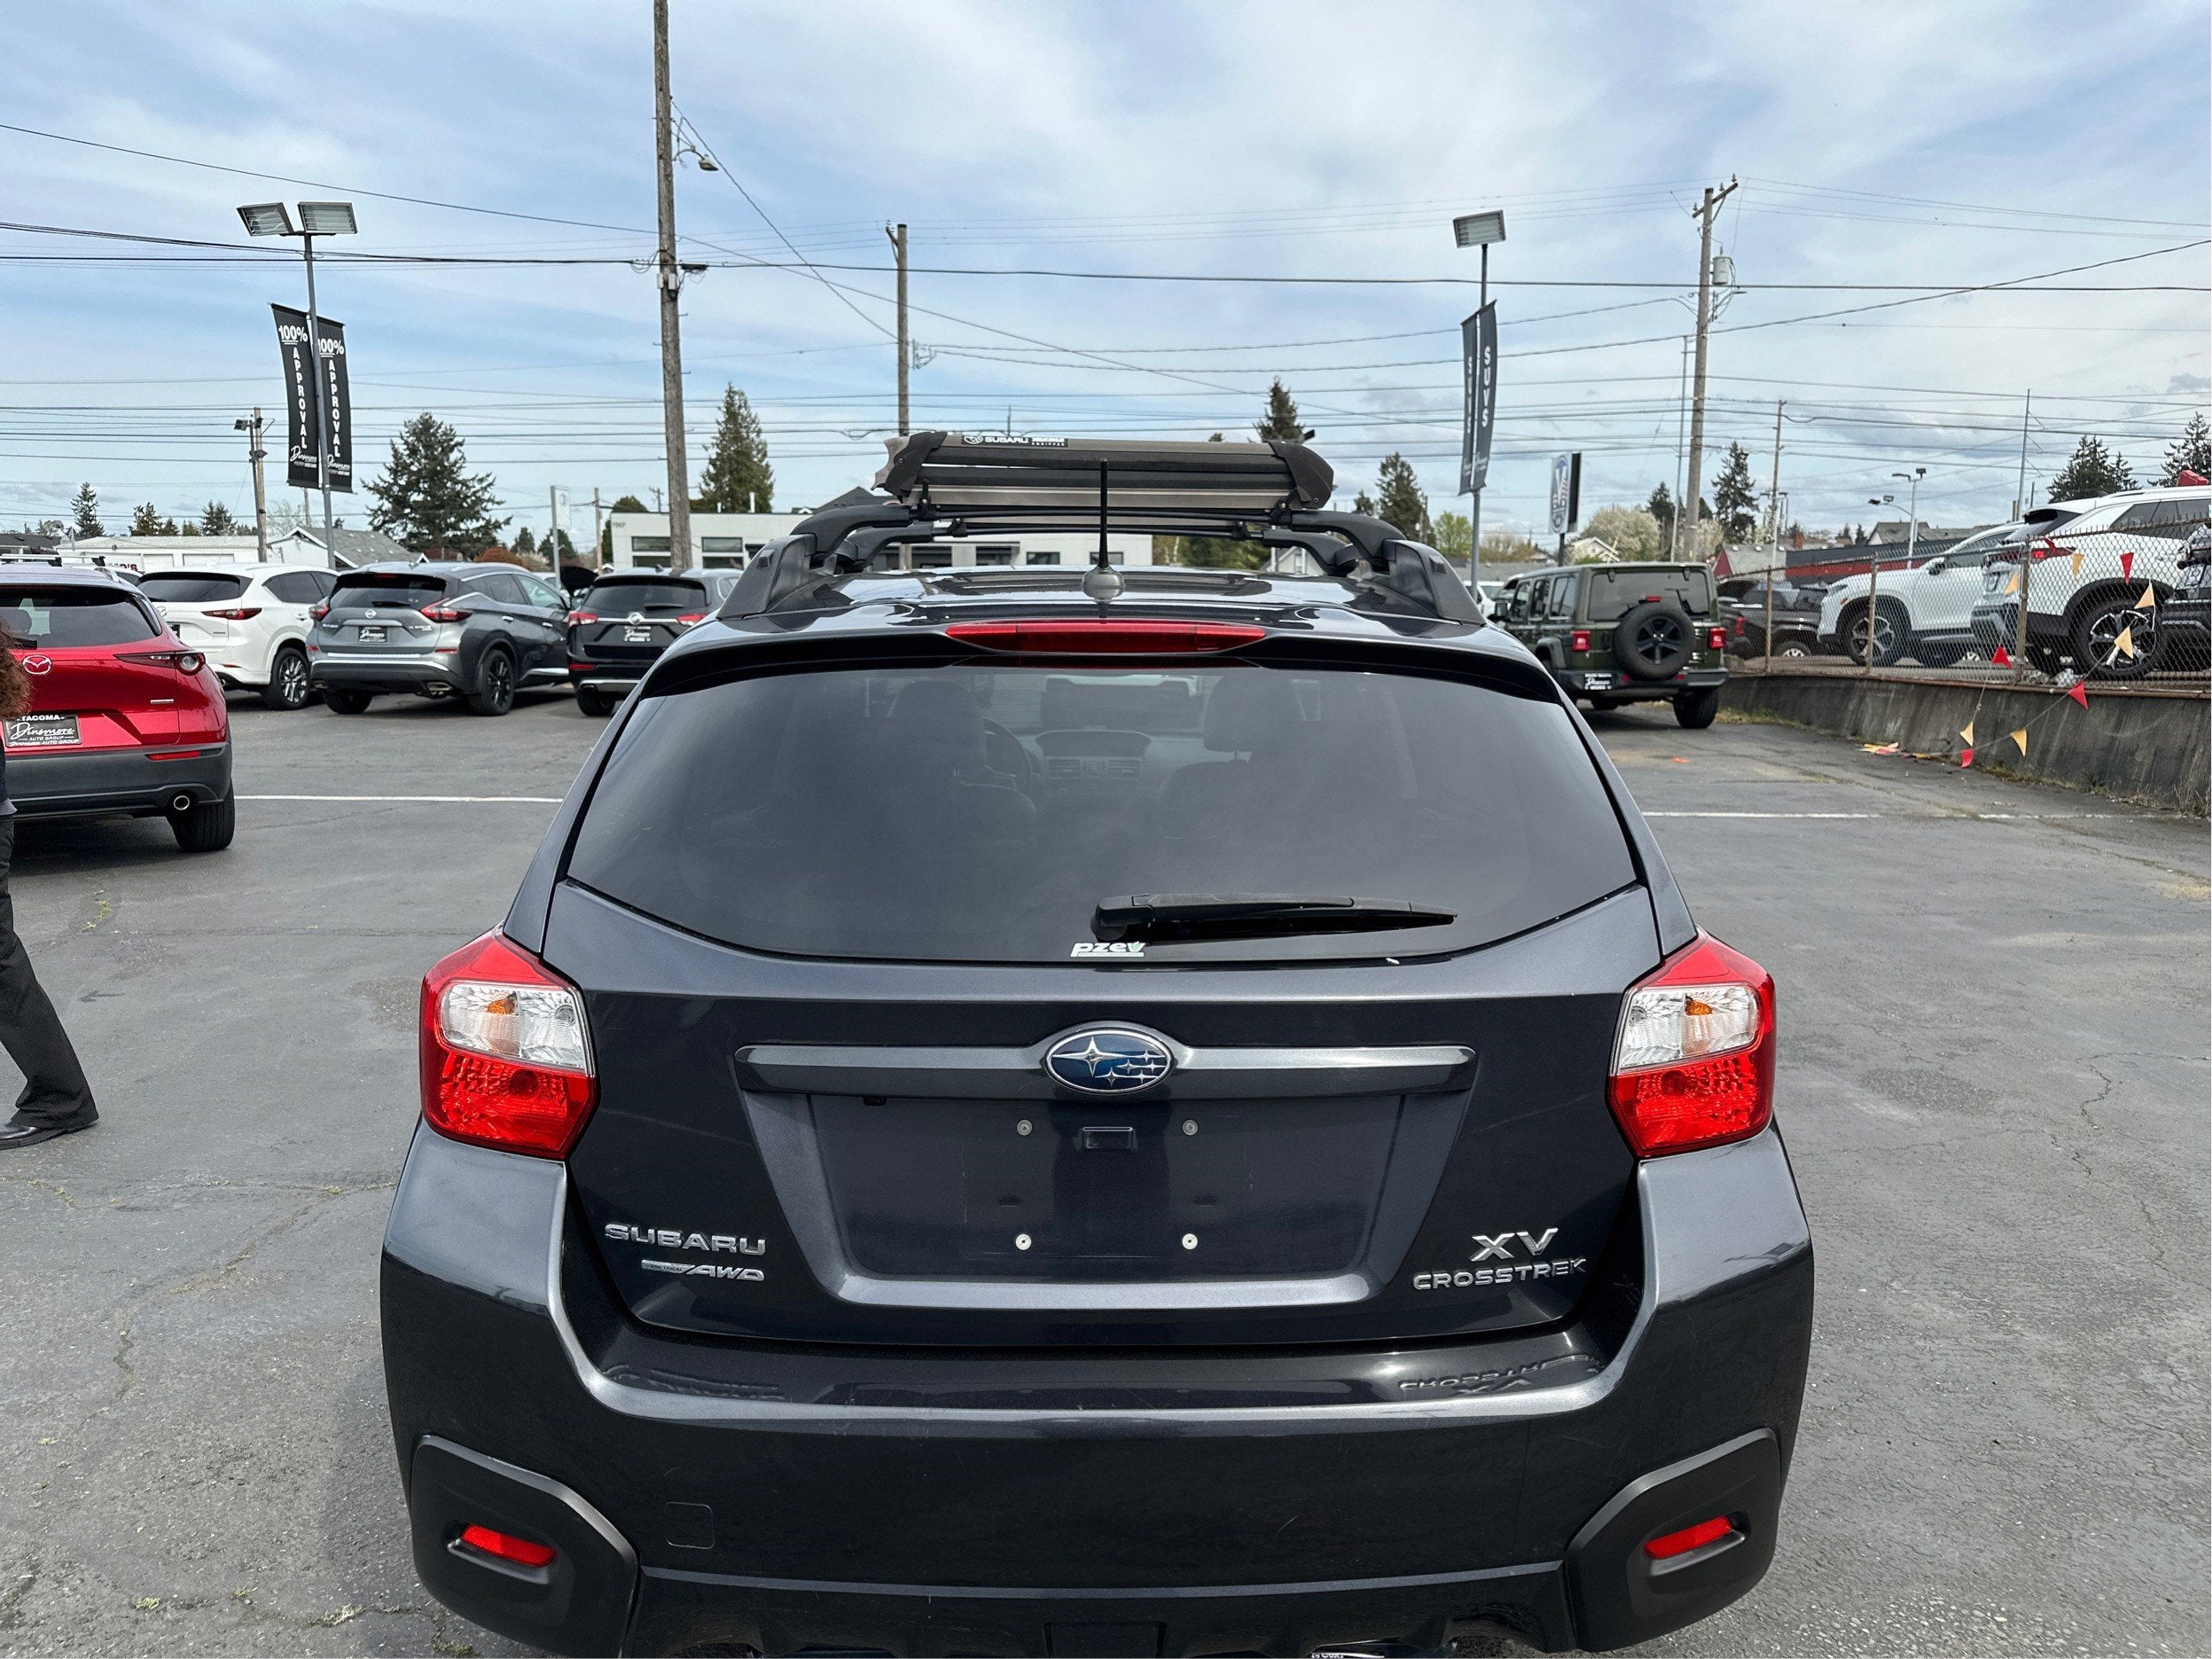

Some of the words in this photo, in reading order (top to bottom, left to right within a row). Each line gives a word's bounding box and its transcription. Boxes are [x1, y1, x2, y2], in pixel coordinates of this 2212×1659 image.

[278, 325, 309, 342] 100%
[293, 347, 307, 449] APPROVAL
[1481, 346, 1491, 427] SUVS
[329, 359, 340, 458] APPROVAL
[10, 722, 75, 740] Dinsmore
[605, 1223, 766, 1256] SUBARU
[1470, 1227, 1559, 1262] XV
[686, 1264, 765, 1281] AWD
[1413, 1257, 1587, 1290] CROSSTREK
